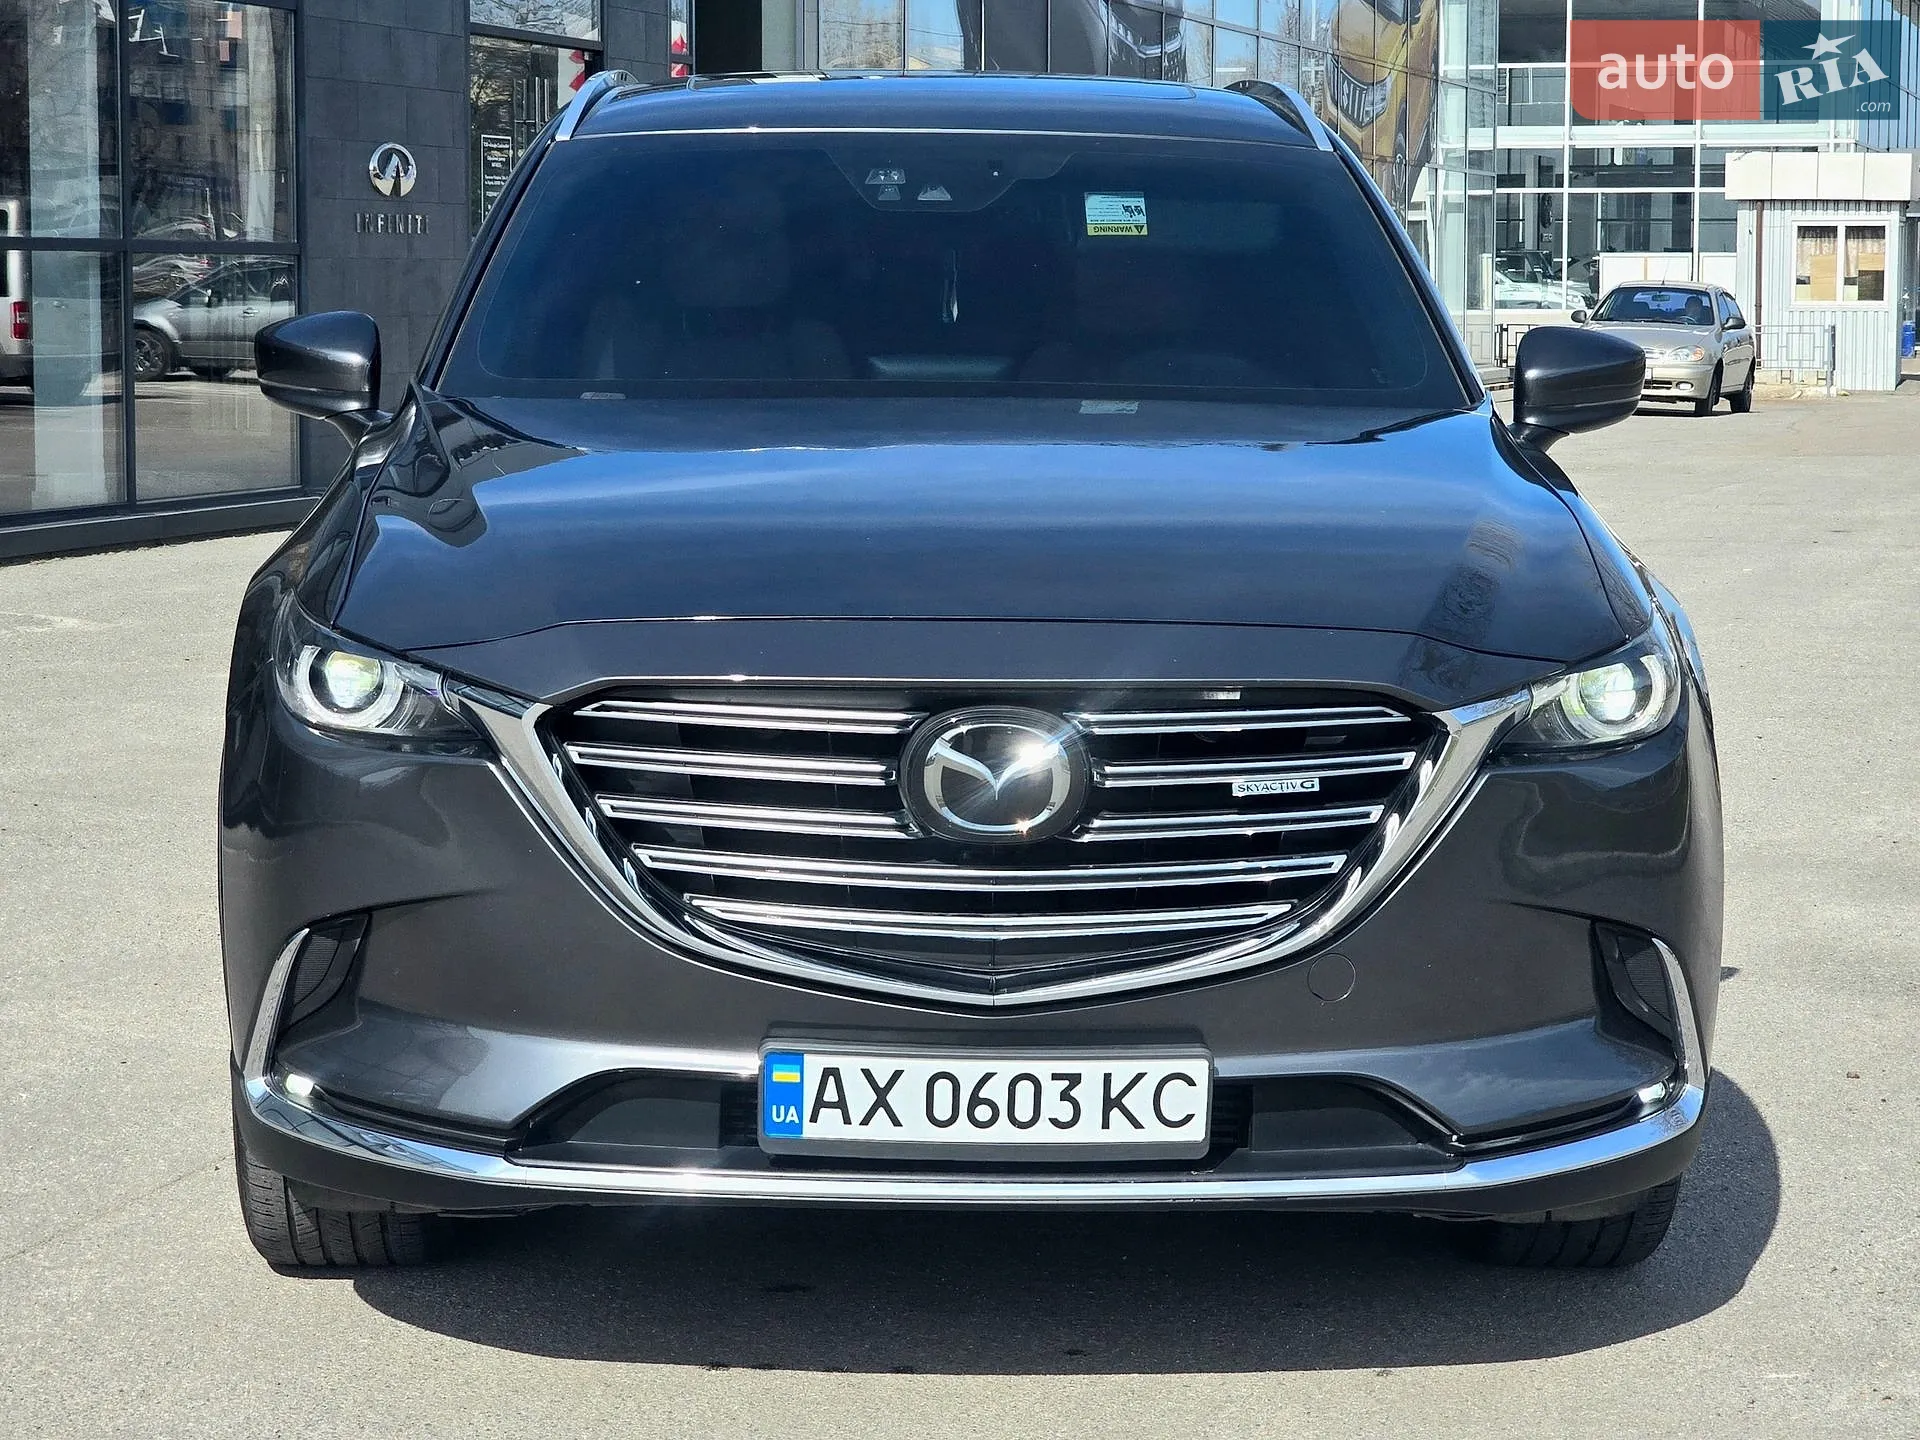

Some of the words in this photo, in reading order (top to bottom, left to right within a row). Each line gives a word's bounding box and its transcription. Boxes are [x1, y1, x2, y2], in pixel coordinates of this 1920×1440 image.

[356, 212, 429, 234] INFINITI
[1093, 225, 1133, 233] WARNING
[808, 1066, 905, 1128] AX
[925, 1070, 1082, 1130] 0603
[1101, 1071, 1197, 1130] KC
[771, 1104, 800, 1125] UA
